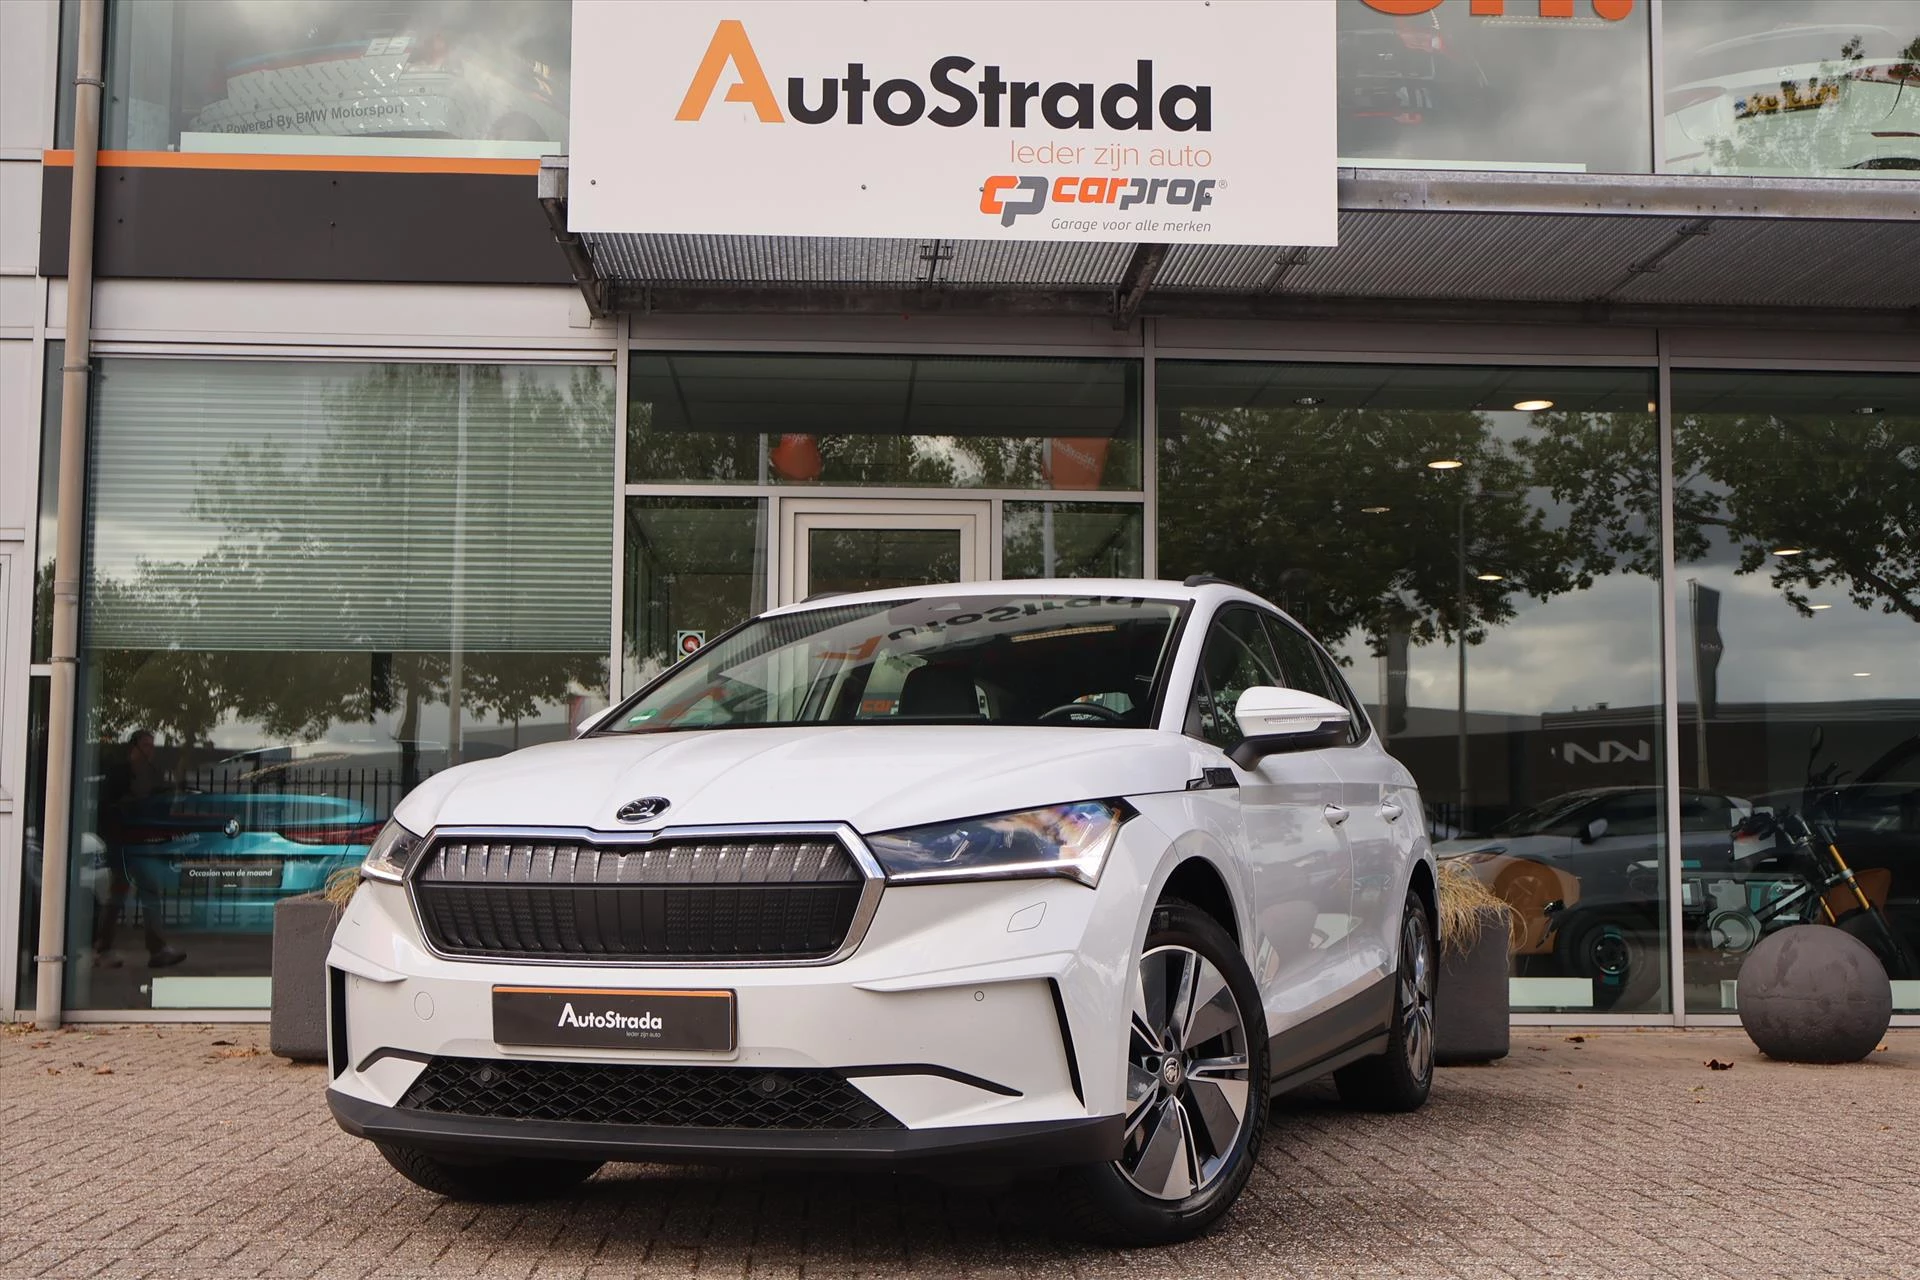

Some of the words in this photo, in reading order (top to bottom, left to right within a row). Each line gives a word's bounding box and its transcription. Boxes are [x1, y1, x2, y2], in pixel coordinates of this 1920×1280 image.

[674, 19, 1212, 132] AutoStrada
[226, 115, 274, 133] Powered
[276, 114, 293, 129] By
[296, 105, 328, 125] BMW
[331, 103, 406, 120] Motorsport
[1010, 139, 1086, 165] Ieder
[1094, 142, 1140, 172] zijn
[1149, 144, 1213, 168] auto
[1051, 175, 1217, 212] carprof
[1050, 217, 1098, 233] Garage
[1102, 219, 1132, 232] voor
[1135, 218, 1159, 232] alle
[1163, 219, 1212, 232] merken
[189, 867, 221, 878] Occasion
[221, 870, 236, 878] van
[236, 868, 246, 878] de
[246, 868, 273, 878] maand
[557, 1002, 663, 1030] AutoStrada
